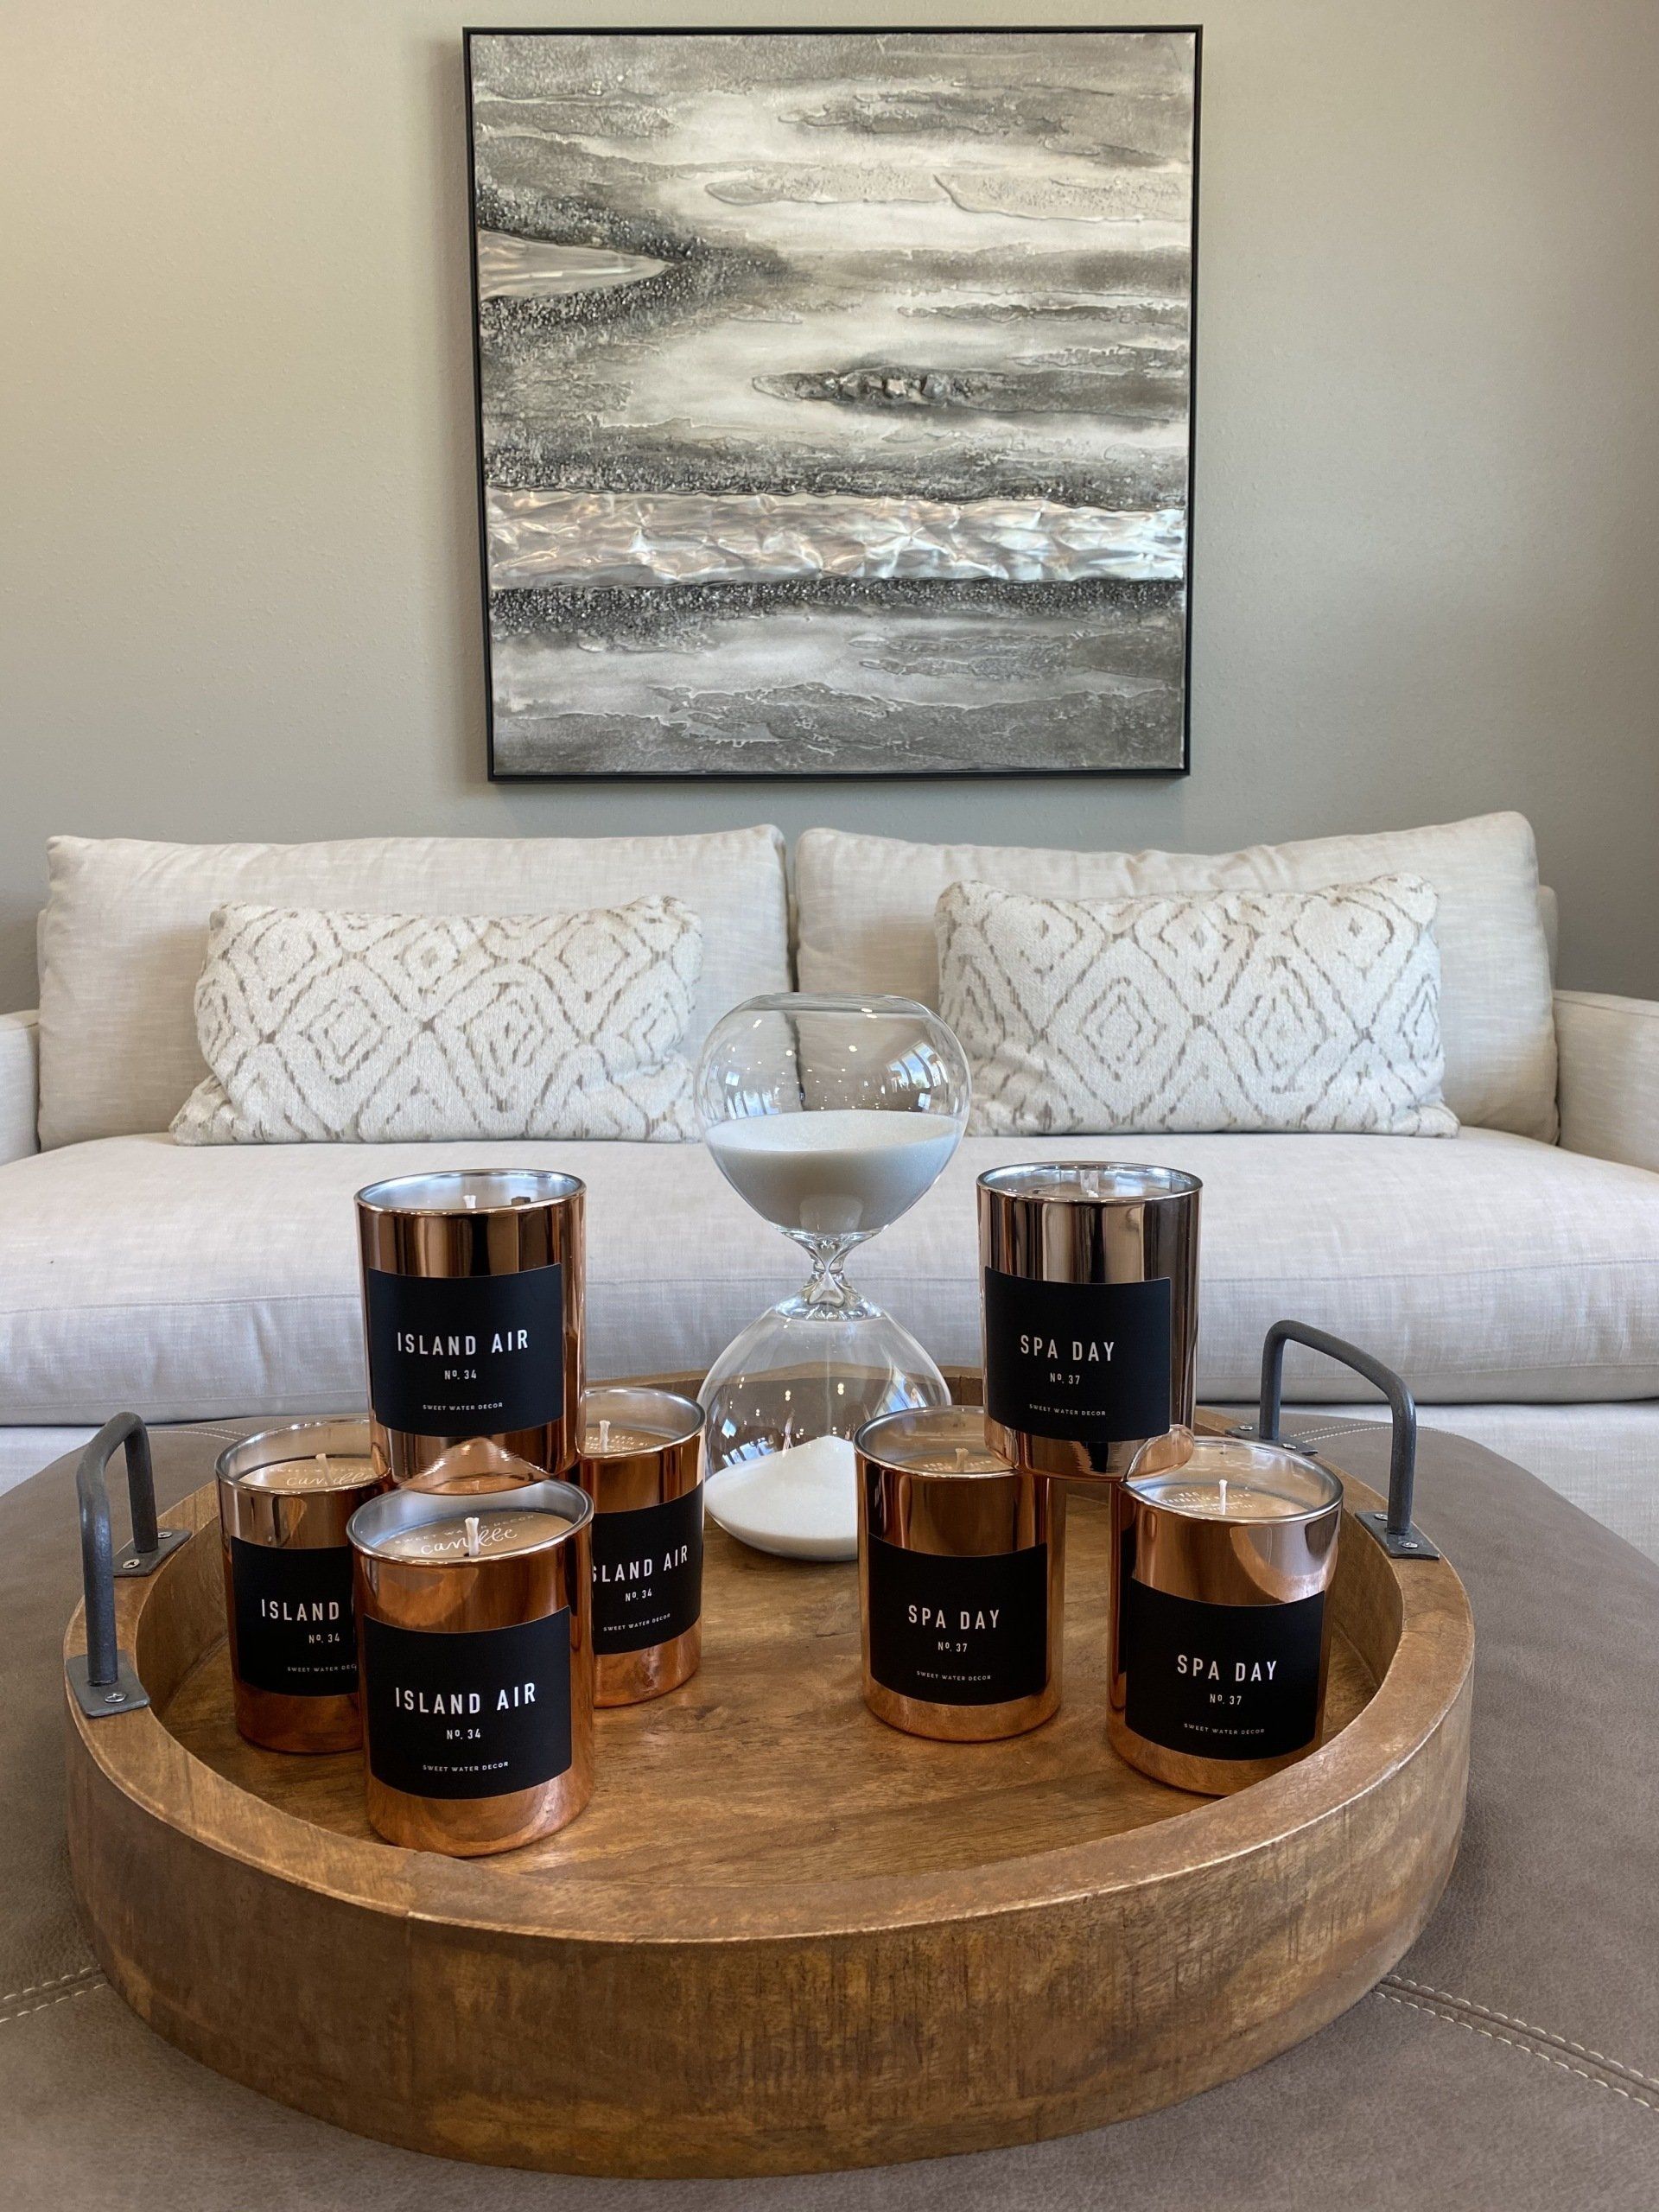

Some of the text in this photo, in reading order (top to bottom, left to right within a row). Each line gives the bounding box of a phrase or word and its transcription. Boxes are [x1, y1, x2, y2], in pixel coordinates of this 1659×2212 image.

[397, 1329, 529, 1356] ISLAND AIR
[1020, 1334, 1115, 1362] SPA DAY
[463, 1369, 477, 1380] 34
[1068, 1374, 1080, 1385] 37
[478, 1402, 503, 1410] DECOR
[592, 1544, 688, 1583] LAND AIR
[641, 1587, 652, 1599] 34
[261, 1599, 340, 1622] ISLAND
[908, 1605, 1000, 1630] SPA DAY
[628, 1620, 650, 1629] WATER
[327, 1632, 340, 1643] 34
[956, 1643, 969, 1653] 37
[1177, 1654, 1277, 1682] SPA DAY
[395, 1682, 536, 1715] ISLAND AIR
[1229, 1695, 1242, 1706] 37
[1184, 1723, 1209, 1732] SWEET
[467, 1728, 481, 1739] 34
[481, 1761, 509, 1771] DECOR
